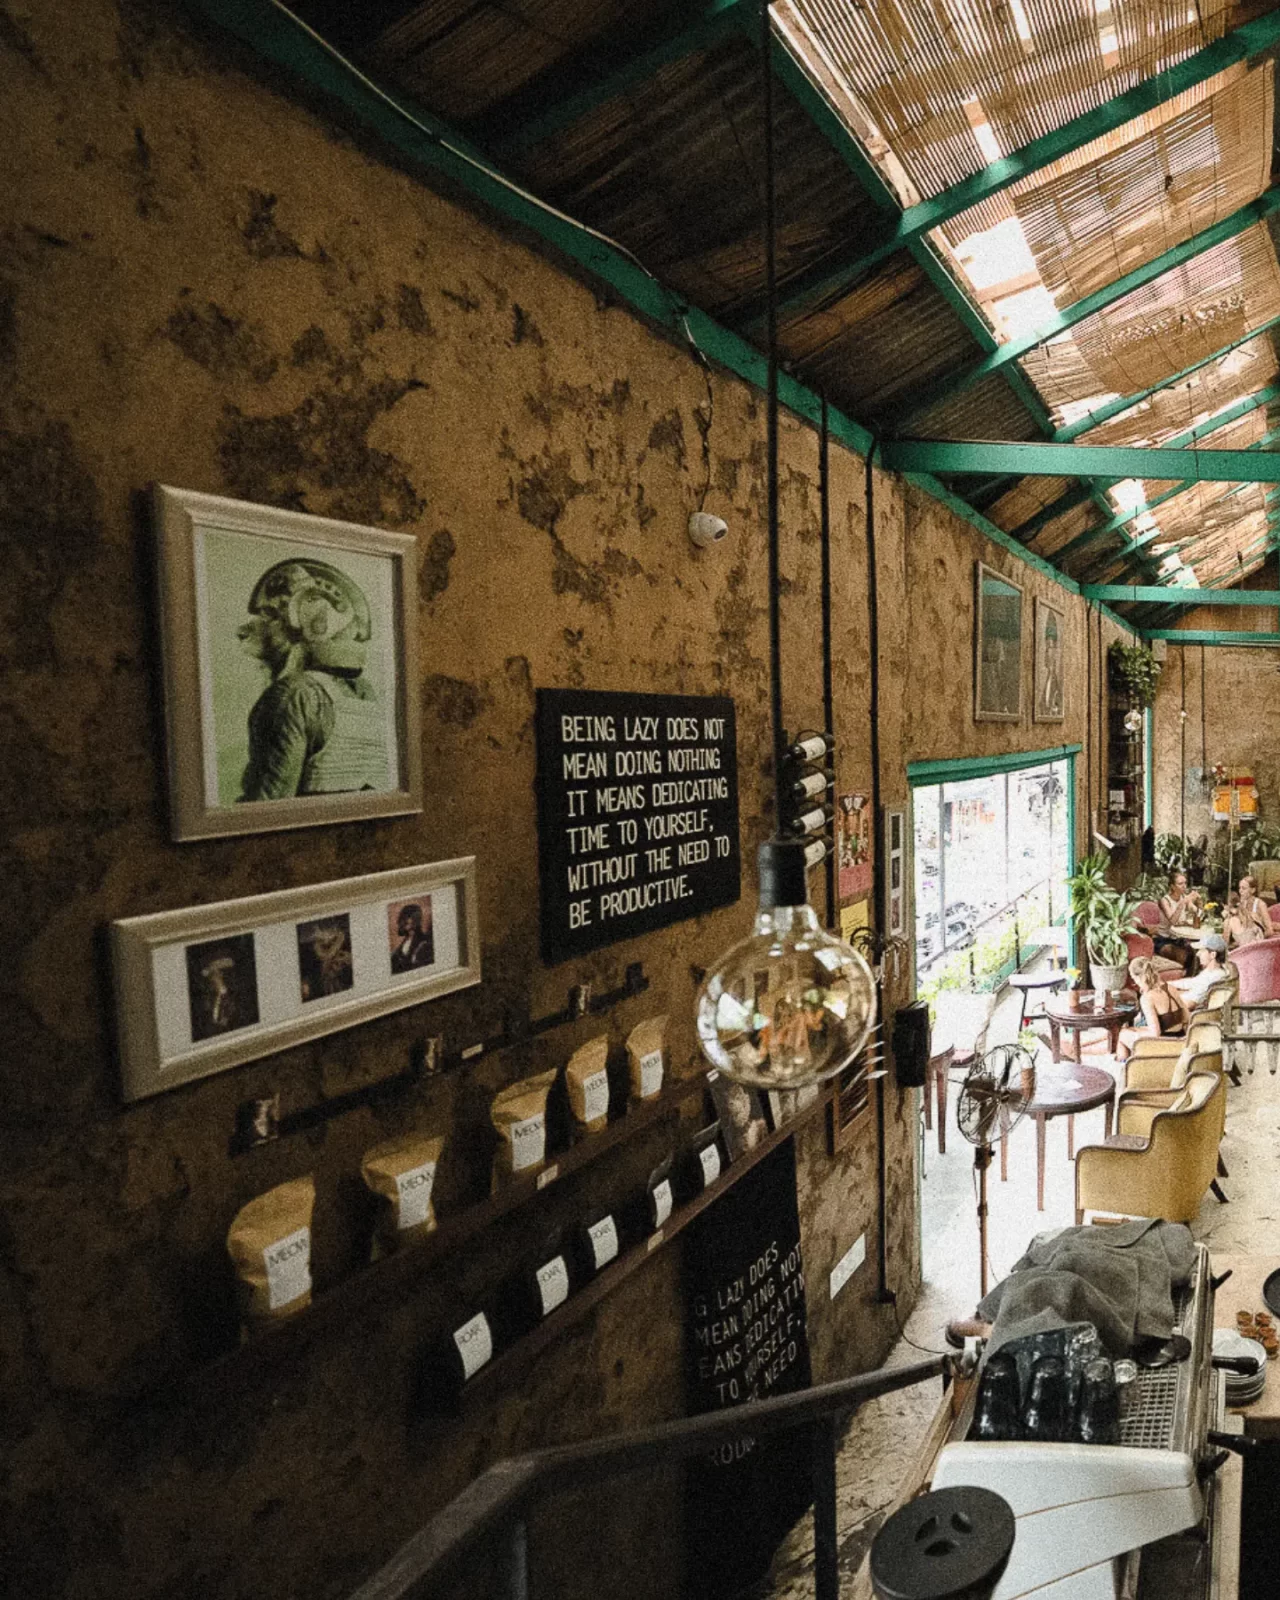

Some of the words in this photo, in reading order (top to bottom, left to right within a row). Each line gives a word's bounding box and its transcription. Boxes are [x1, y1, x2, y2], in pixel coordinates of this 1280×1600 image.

[561, 715, 616, 743] BEING
[623, 716, 660, 742] LAZY
[666, 717, 698, 742] DOES
[703, 718, 726, 741] NOT
[563, 752, 607, 780] MEAN
[615, 750, 662, 777] DOING
[668, 747, 721, 773] NOTHING
[567, 790, 589, 817] IT
[596, 785, 645, 814] MEANS
[652, 776, 729, 808] DEDICATING
[566, 823, 610, 854] TIME
[617, 819, 638, 846] TO
[644, 808, 714, 842] YOURSELF,
[567, 853, 638, 893] WITHOUT
[645, 846, 672, 874] THE
[678, 839, 709, 867] NEED
[714, 834, 730, 858] TO
[569, 899, 592, 930] BE
[600, 874, 694, 920] PRODUCTIVE.
[749, 1240, 779, 1287] DOES
[695, 1315, 739, 1347] MEAN
[764, 1340, 797, 1390] NEED
[715, 1377, 739, 1406] TO
